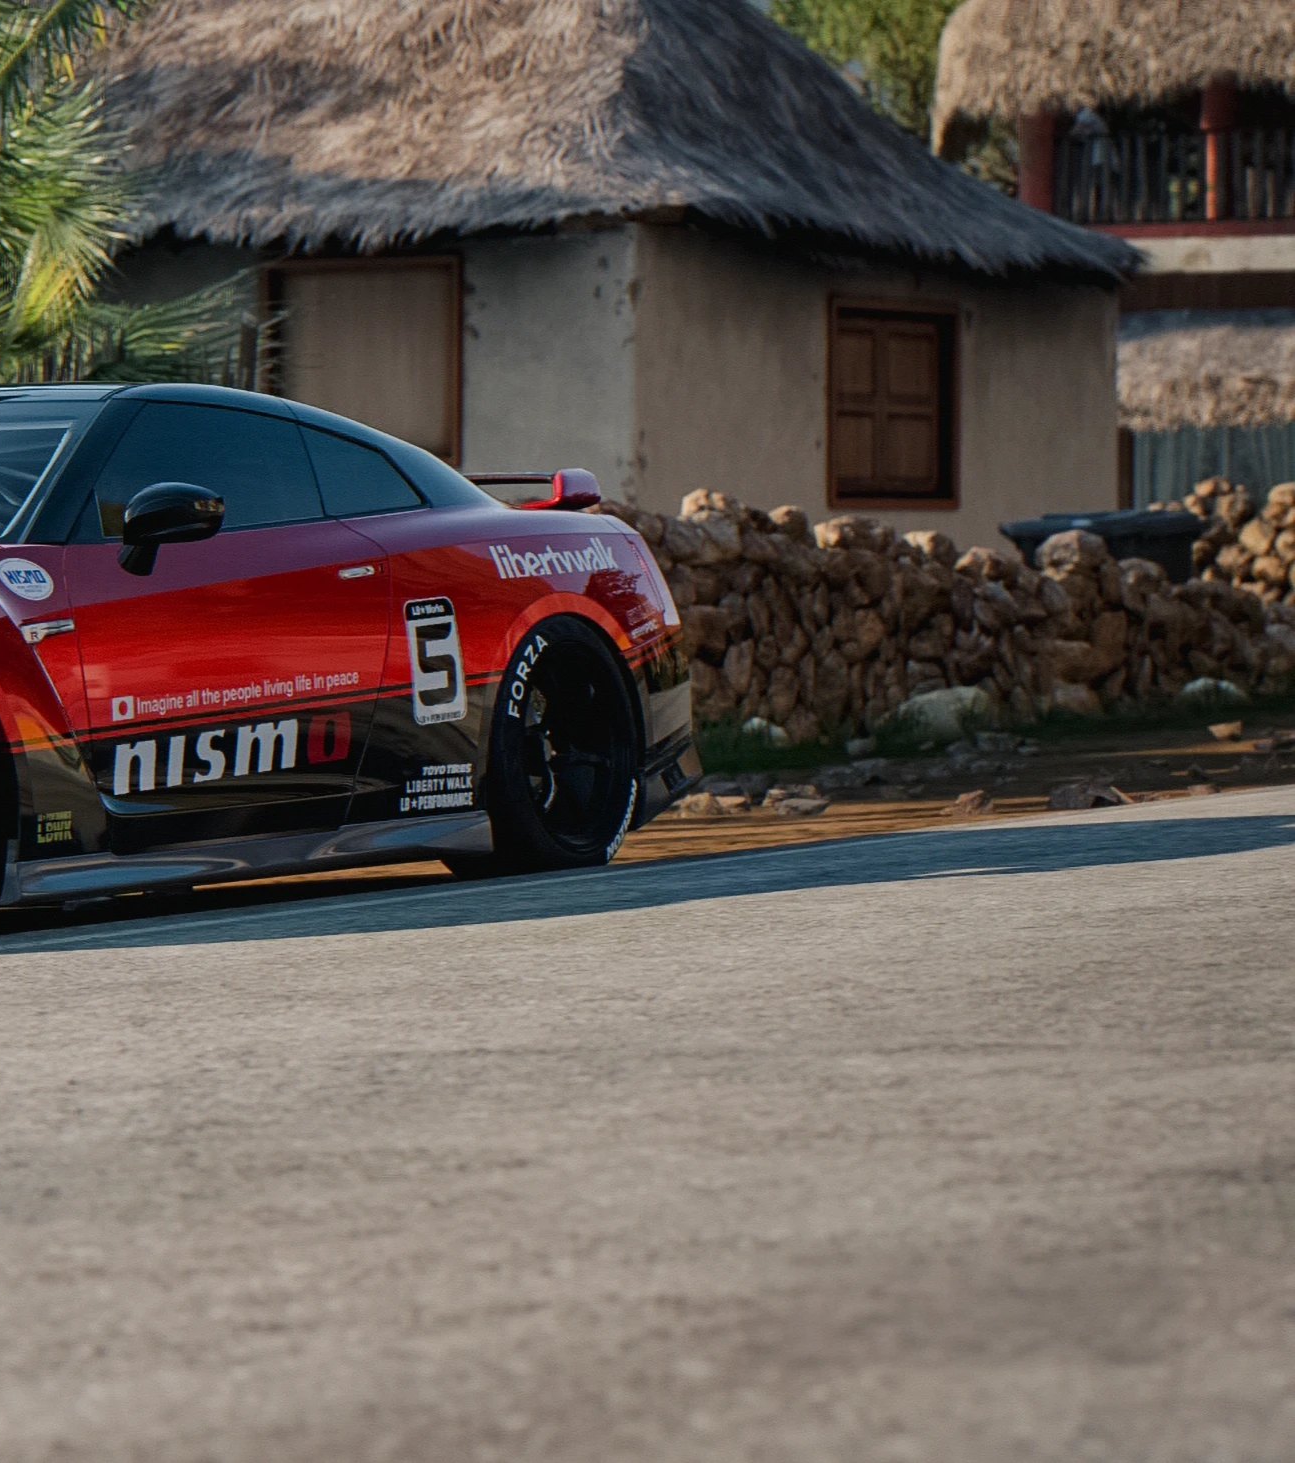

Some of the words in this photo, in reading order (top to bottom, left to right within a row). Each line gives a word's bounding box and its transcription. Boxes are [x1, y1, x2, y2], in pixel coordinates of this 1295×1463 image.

[2, 569, 47, 585] NISMO
[488, 537, 619, 579] libertywalk
[414, 621, 457, 707] 5
[508, 634, 549, 718] FORZA
[137, 693, 184, 715] Imagine
[185, 691, 199, 707] all
[202, 688, 220, 704] the
[222, 682, 262, 704] people
[264, 678, 293, 696] living
[295, 675, 312, 691] life
[313, 674, 325, 689] in
[326, 672, 359, 690] peace
[113, 711, 352, 796] nismo
[422, 765, 446, 776] TOYO
[406, 779, 445, 794] LIBERTY
[446, 775, 473, 790] WALK
